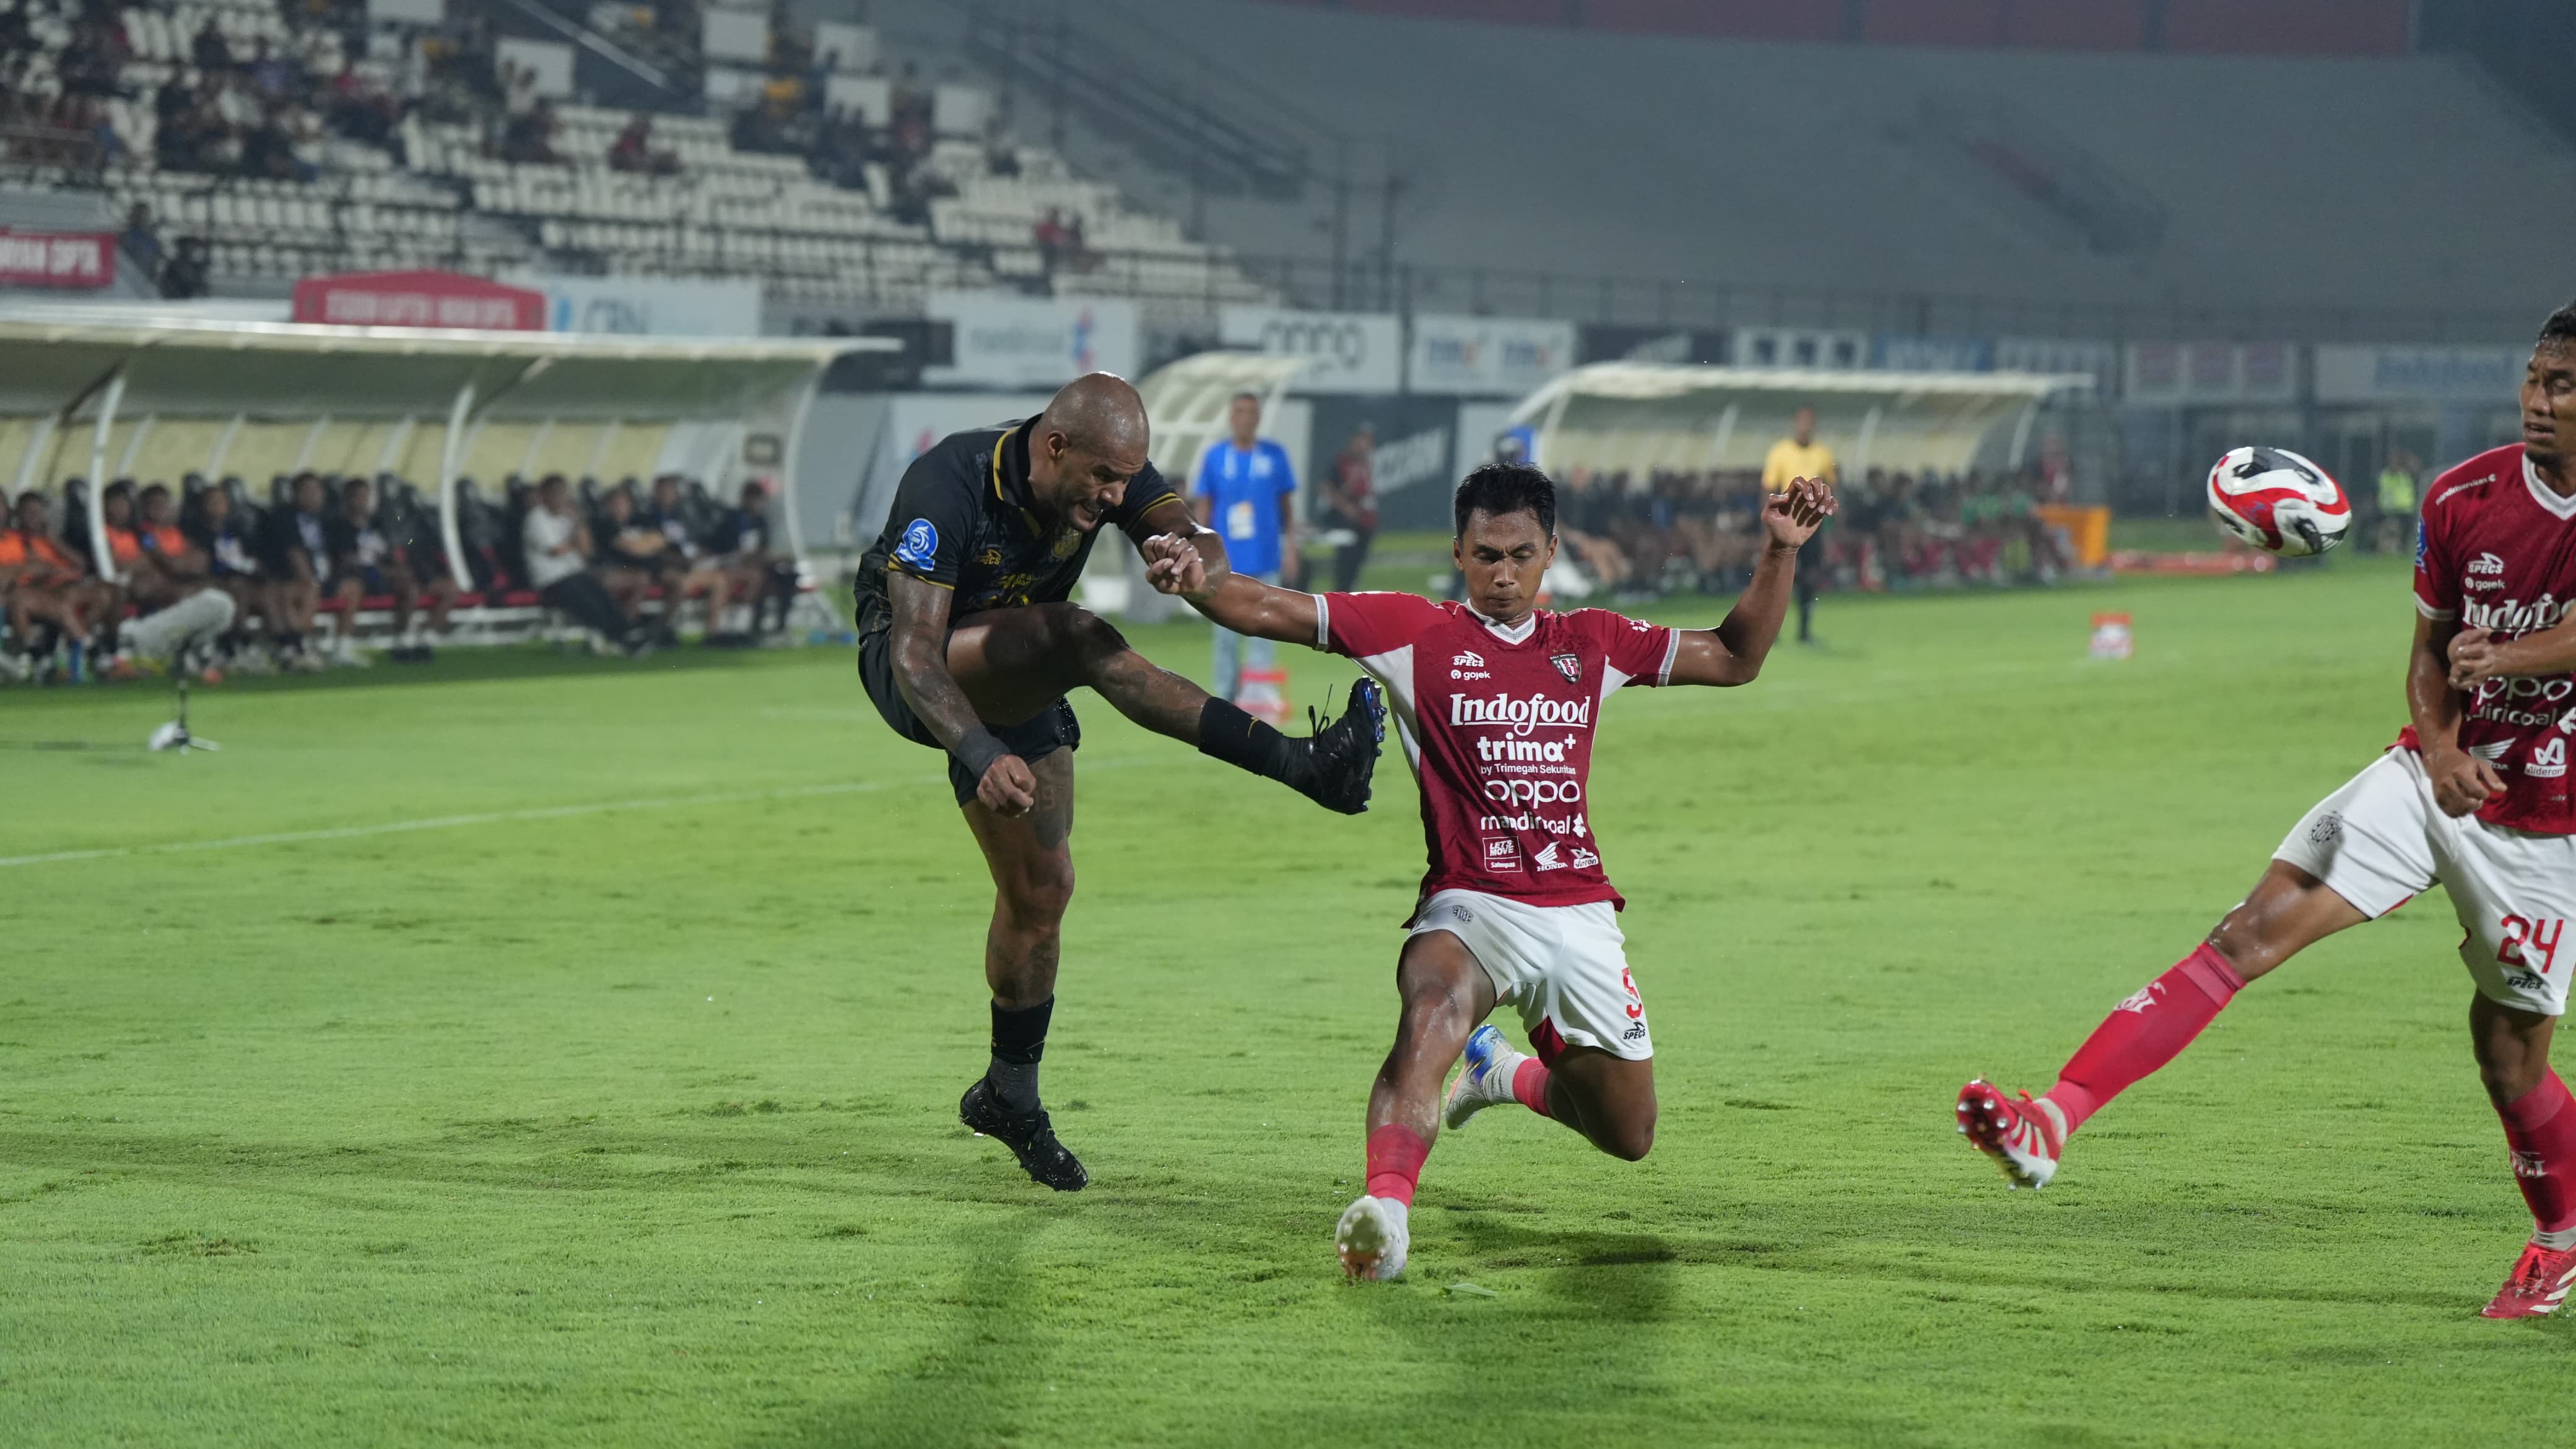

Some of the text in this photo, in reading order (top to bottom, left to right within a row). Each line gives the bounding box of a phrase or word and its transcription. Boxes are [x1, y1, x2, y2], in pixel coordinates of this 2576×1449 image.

[2468, 564, 2503, 574] SPECS
[2475, 580, 2505, 591] gojek
[1453, 658, 1484, 667] SPECS
[1463, 671, 1491, 681] gojek
[2469, 676, 2573, 705] ppo
[1449, 693, 1591, 736] Indofood
[1481, 763, 1576, 776] by Trimegah Sekuritas
[2526, 765, 2564, 776] Alderon
[1484, 780, 1580, 809] oppo
[1490, 845, 1514, 856] MOVE
[1536, 862, 1568, 872] HONDA
[2497, 913, 2564, 974] 24
[2506, 977, 2542, 990] SPECS
[1621, 966, 1643, 1019] 5
[1622, 1029, 1646, 1040] SPECS
